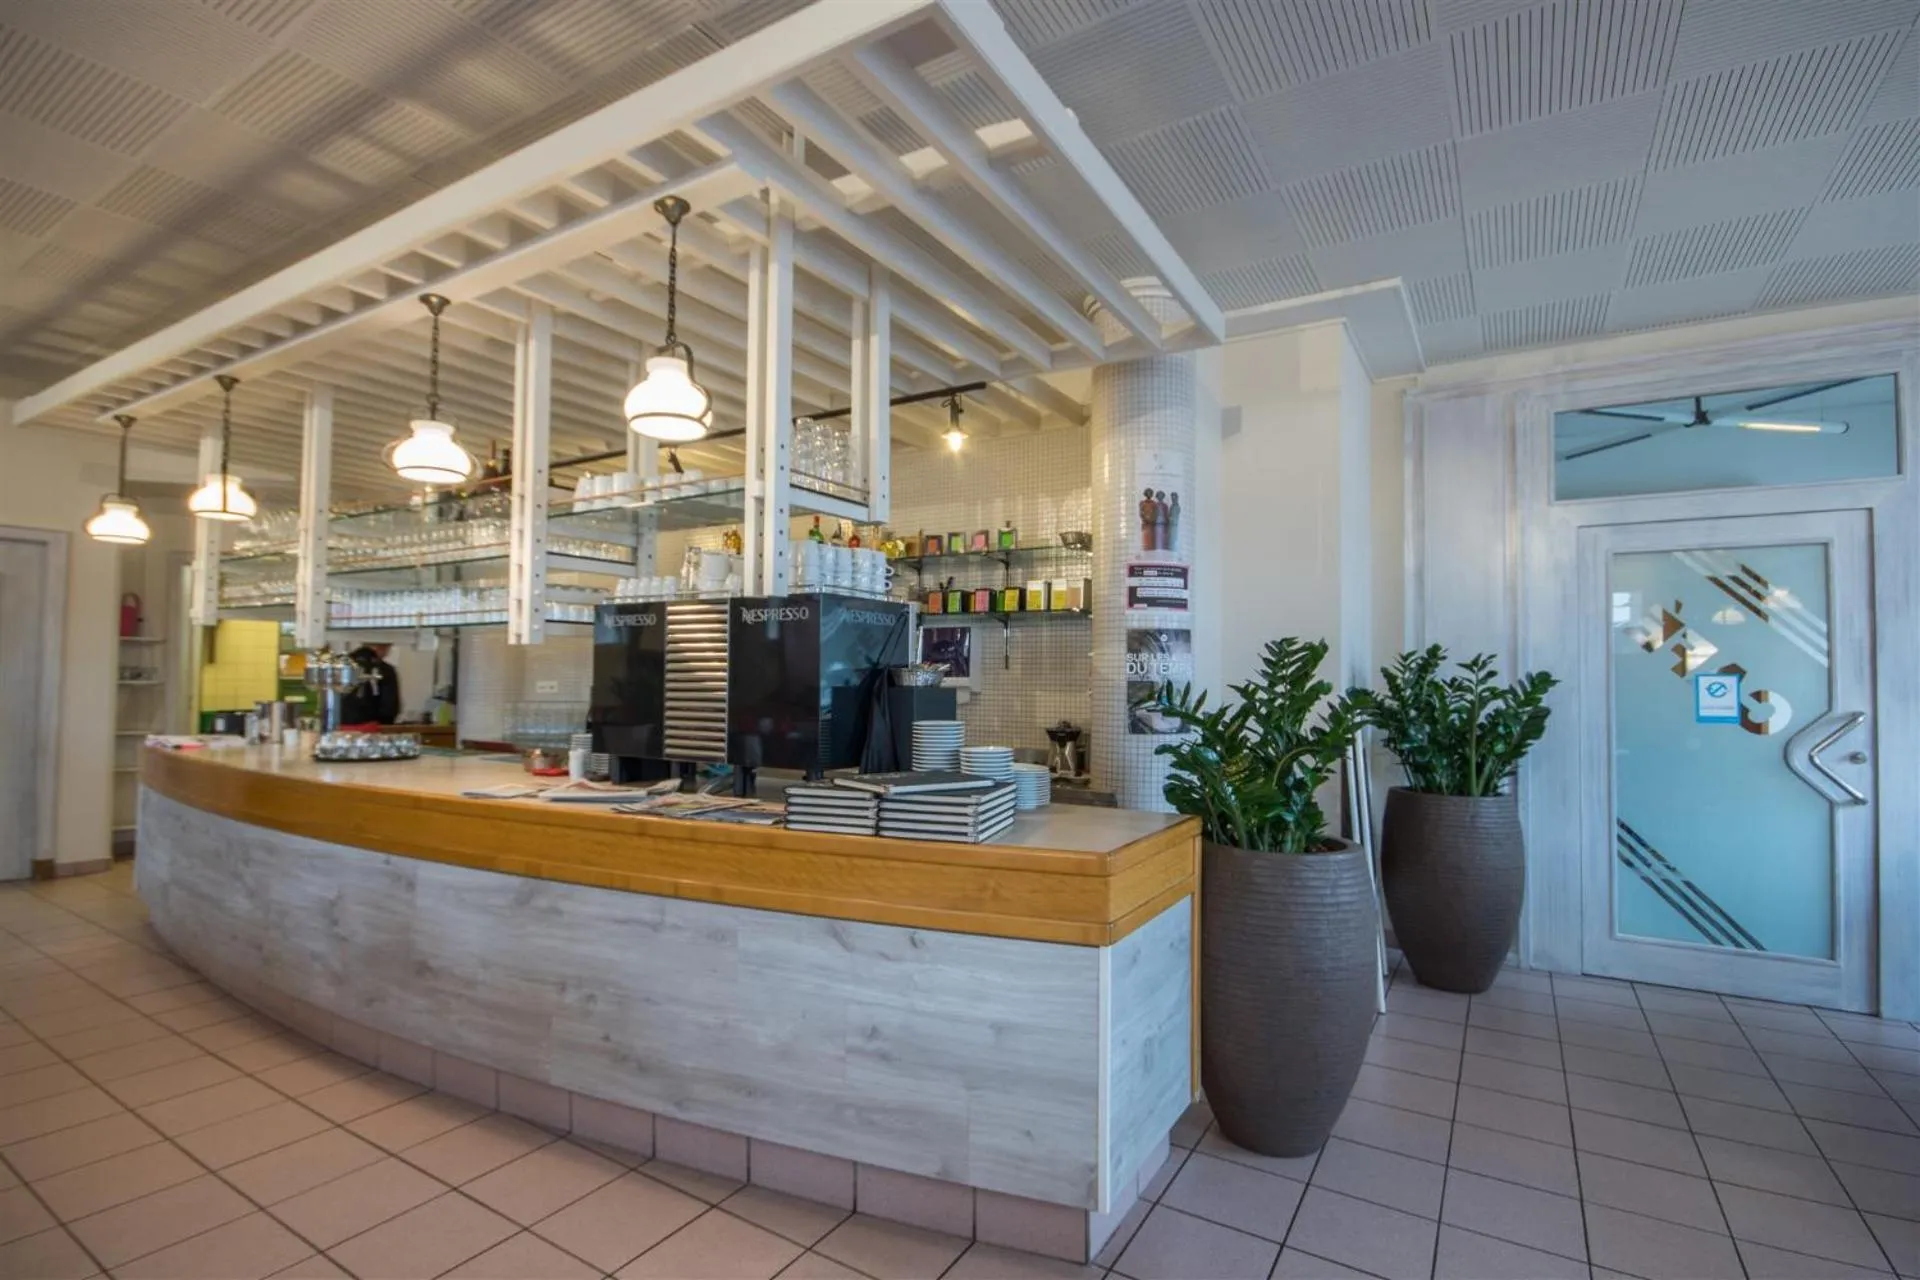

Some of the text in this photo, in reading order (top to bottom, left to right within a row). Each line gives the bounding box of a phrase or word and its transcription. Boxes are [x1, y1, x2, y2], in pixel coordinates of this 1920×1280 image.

[604, 613, 657, 628] NESPRESSO
[740, 606, 809, 625] NESPRESSO
[1126, 662, 1148, 674] DU
